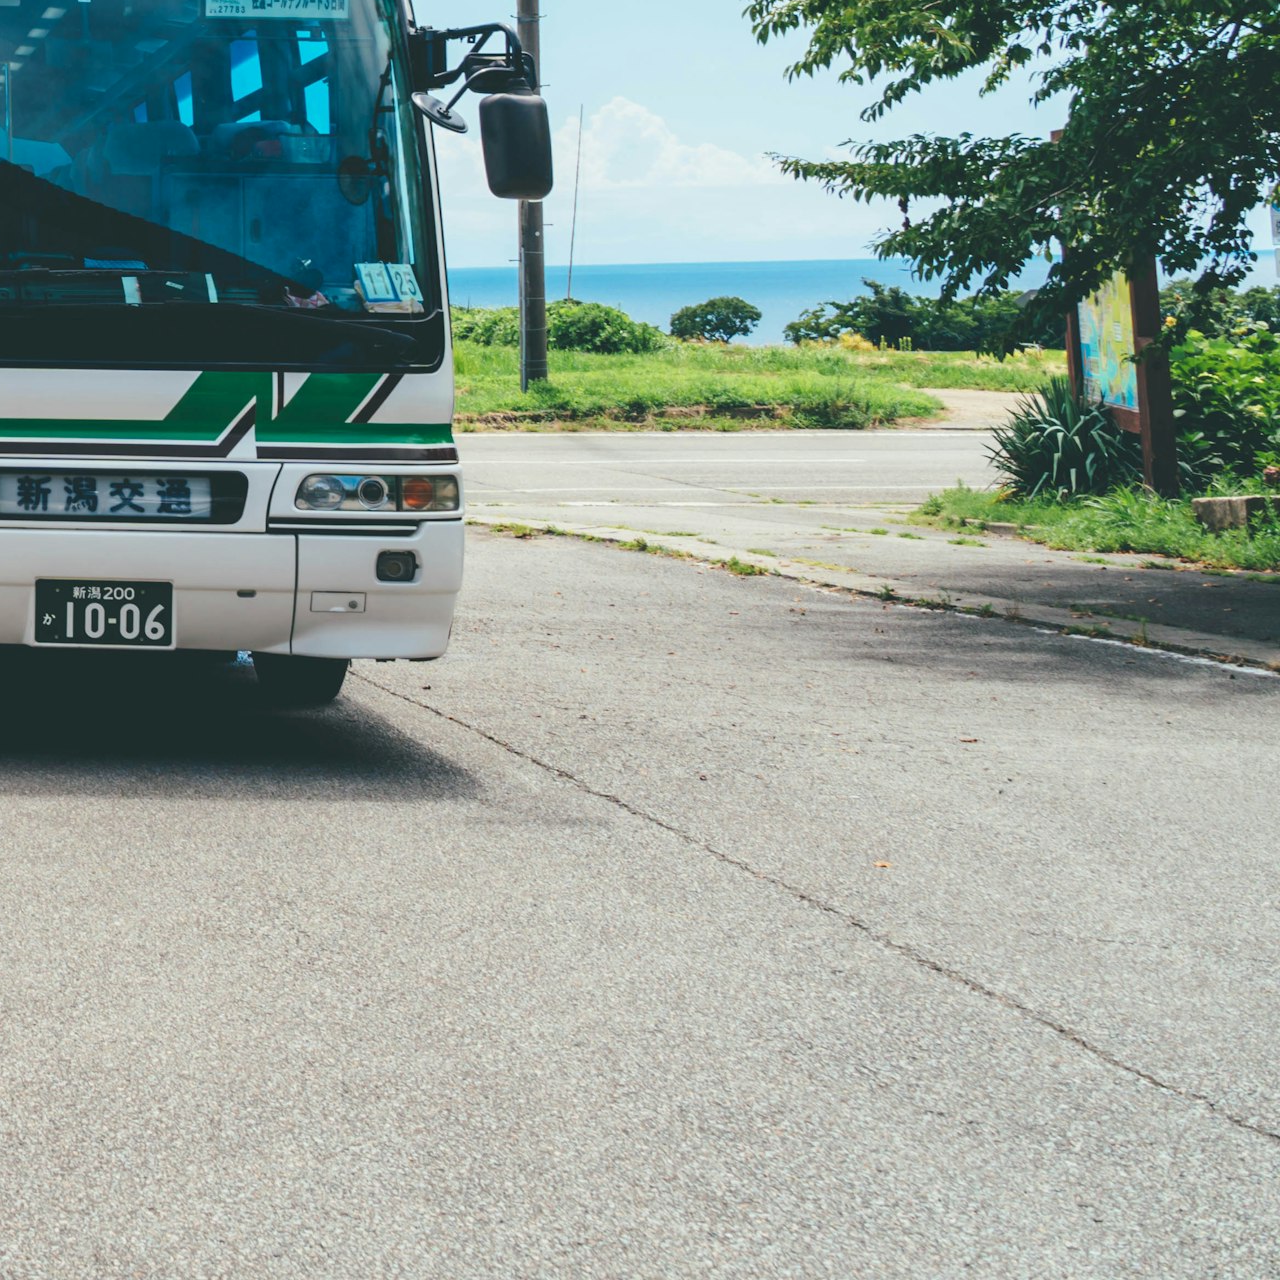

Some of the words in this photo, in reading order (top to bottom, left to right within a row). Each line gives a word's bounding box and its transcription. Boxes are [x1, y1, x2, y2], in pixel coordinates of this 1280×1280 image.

[394, 271, 418, 296] 25
[16, 475, 192, 514] 新潟交通
[72, 586, 135, 600] 新潟200
[66, 601, 165, 640] 10-06
